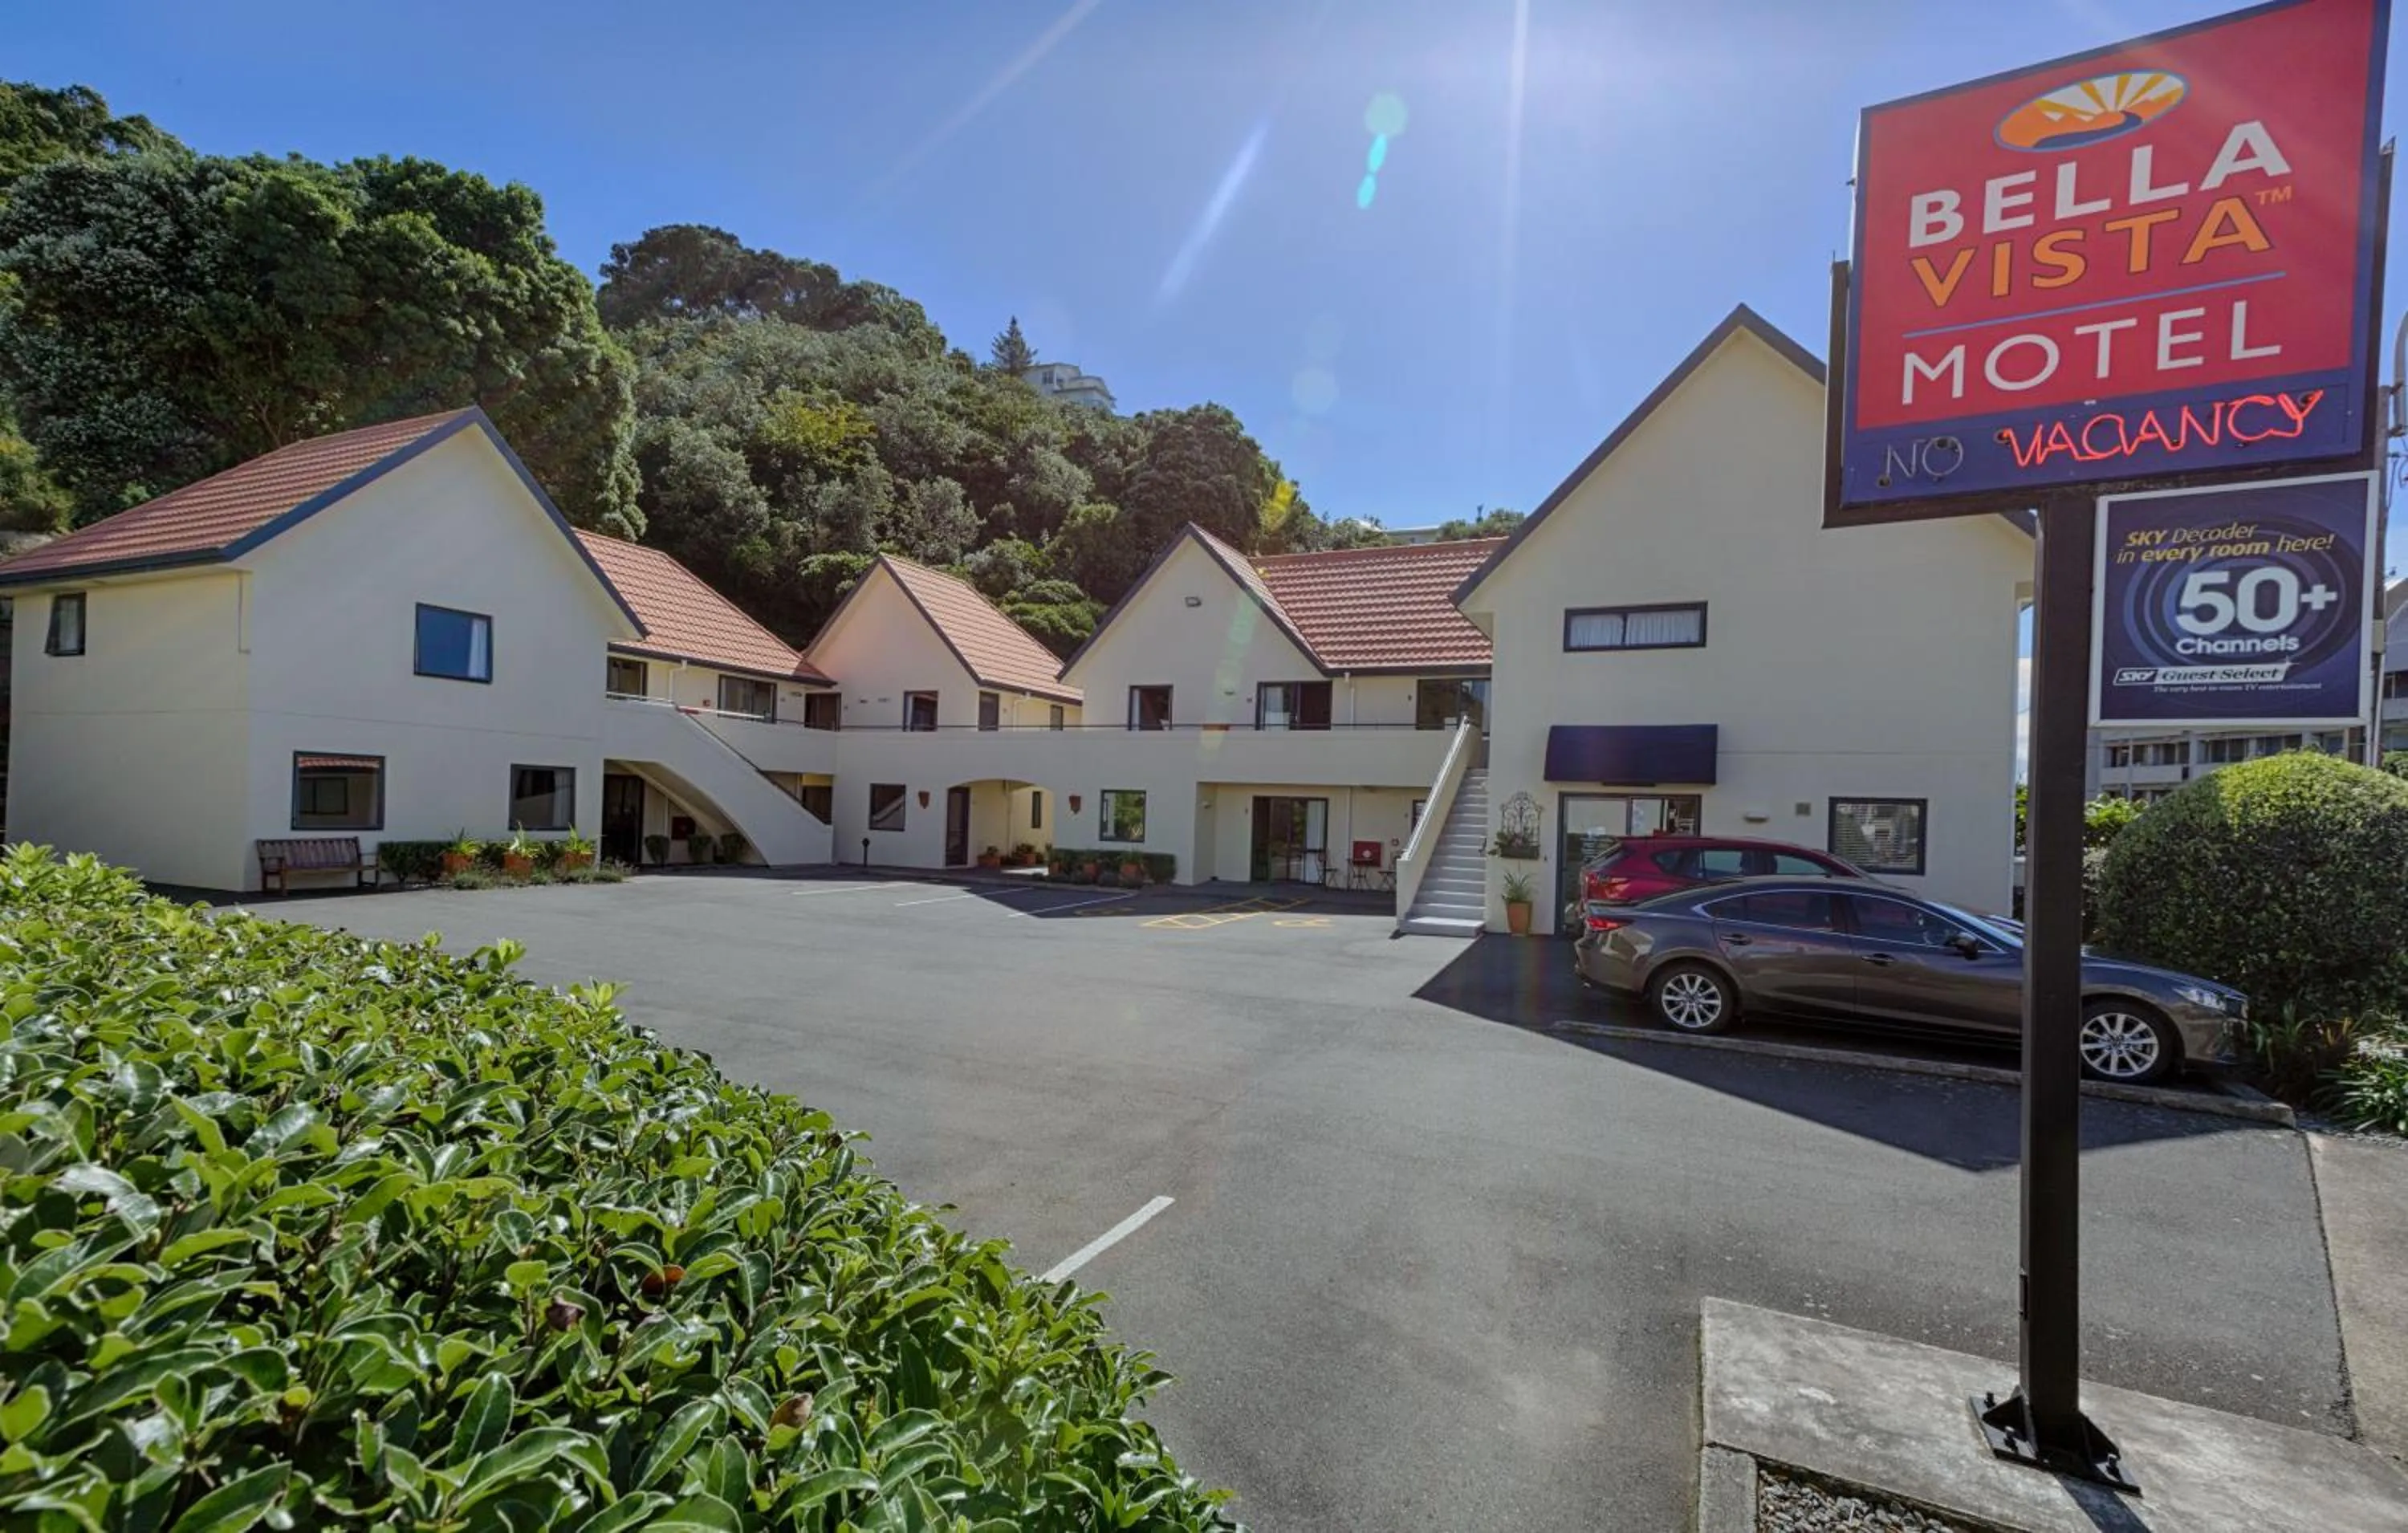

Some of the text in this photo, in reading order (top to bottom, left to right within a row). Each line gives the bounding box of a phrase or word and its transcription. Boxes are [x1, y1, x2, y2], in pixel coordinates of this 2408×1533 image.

[1910, 120, 2292, 248] BELLA
[1910, 185, 2292, 308] VISTA TM
[1902, 300, 2282, 405] MOTEL
[1885, 390, 2324, 477] NO VACANCY
[2117, 534, 2335, 564] in every room here!
[2125, 522, 2259, 547] SKY Decoder
[2175, 566, 2338, 635] 50+
[2119, 667, 2279, 681] SKY Guest Select
[2175, 634, 2300, 655] Channels
